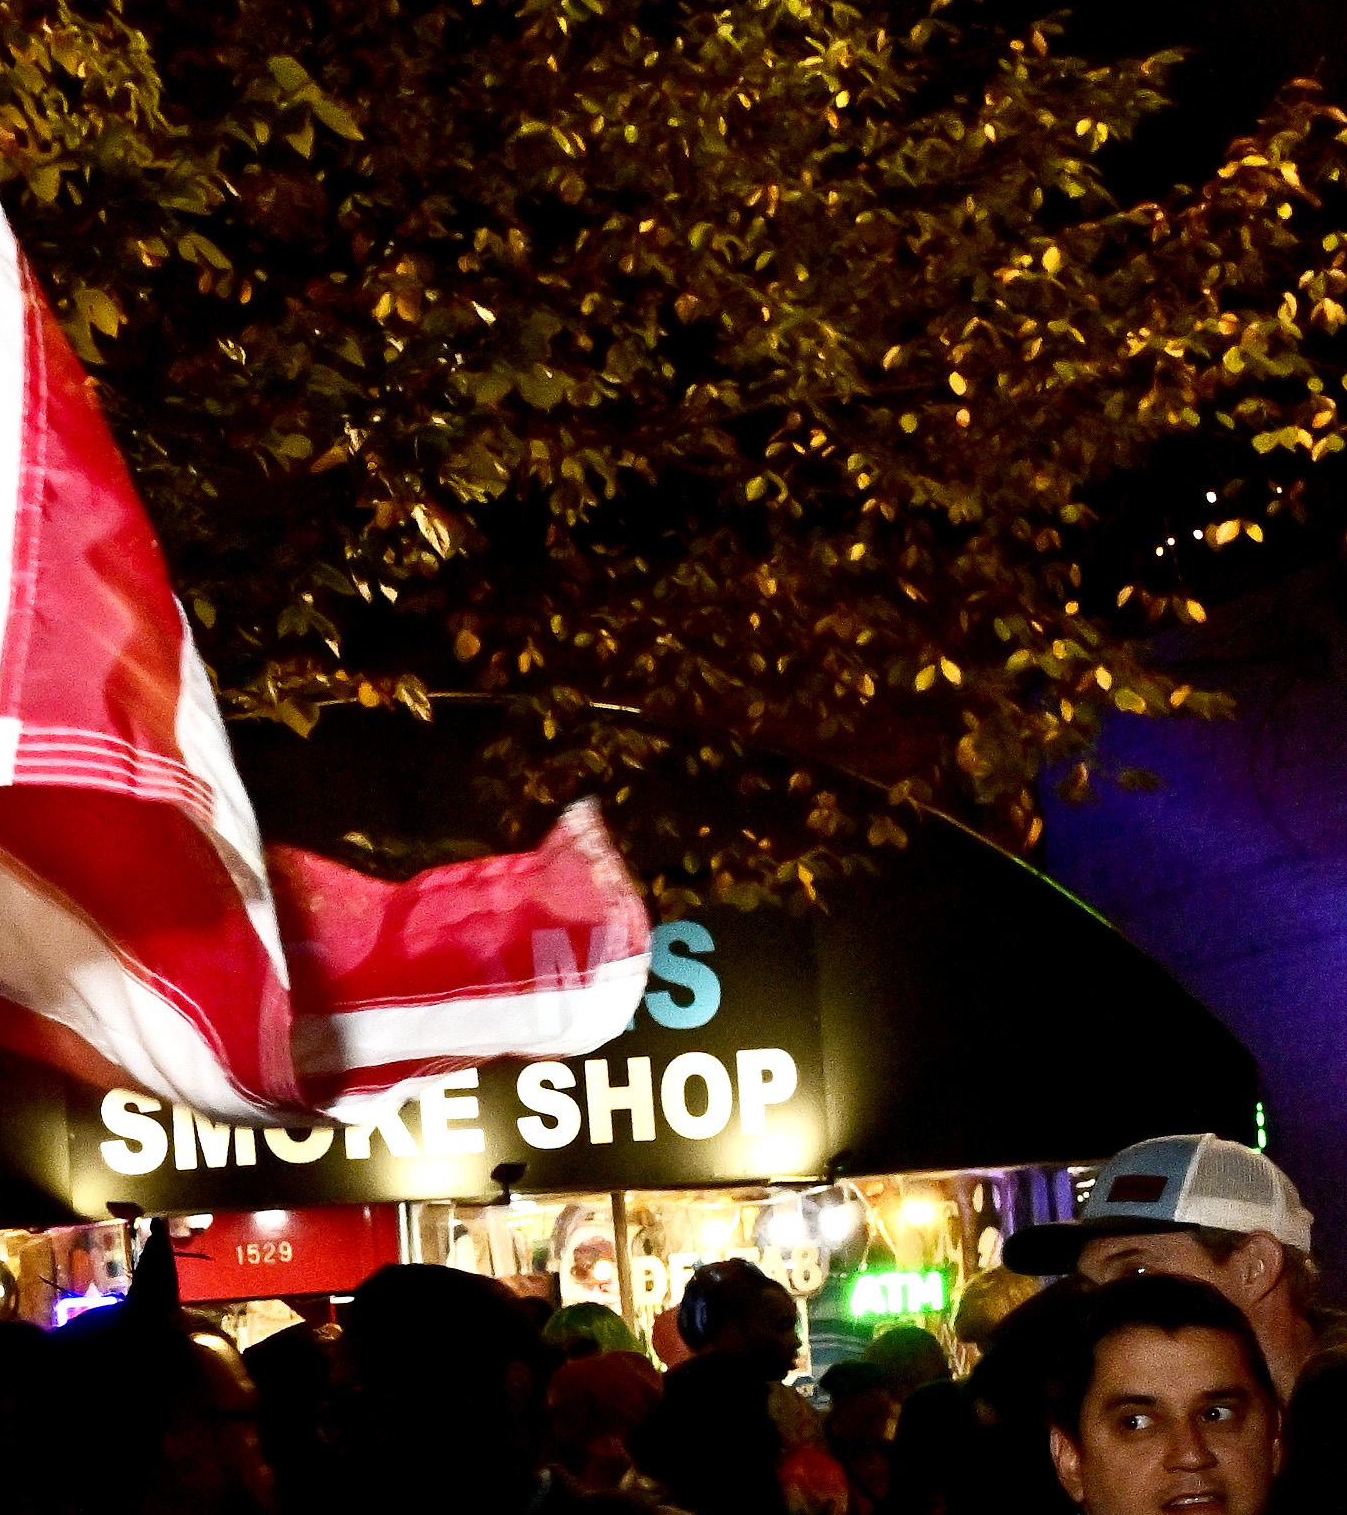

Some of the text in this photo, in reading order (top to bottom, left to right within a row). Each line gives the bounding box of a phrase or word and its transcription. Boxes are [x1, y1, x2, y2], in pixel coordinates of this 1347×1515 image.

[515, 1046, 798, 1152] SHOP
[236, 1240, 293, 1266] 1529
[850, 1270, 944, 1316] ATM
